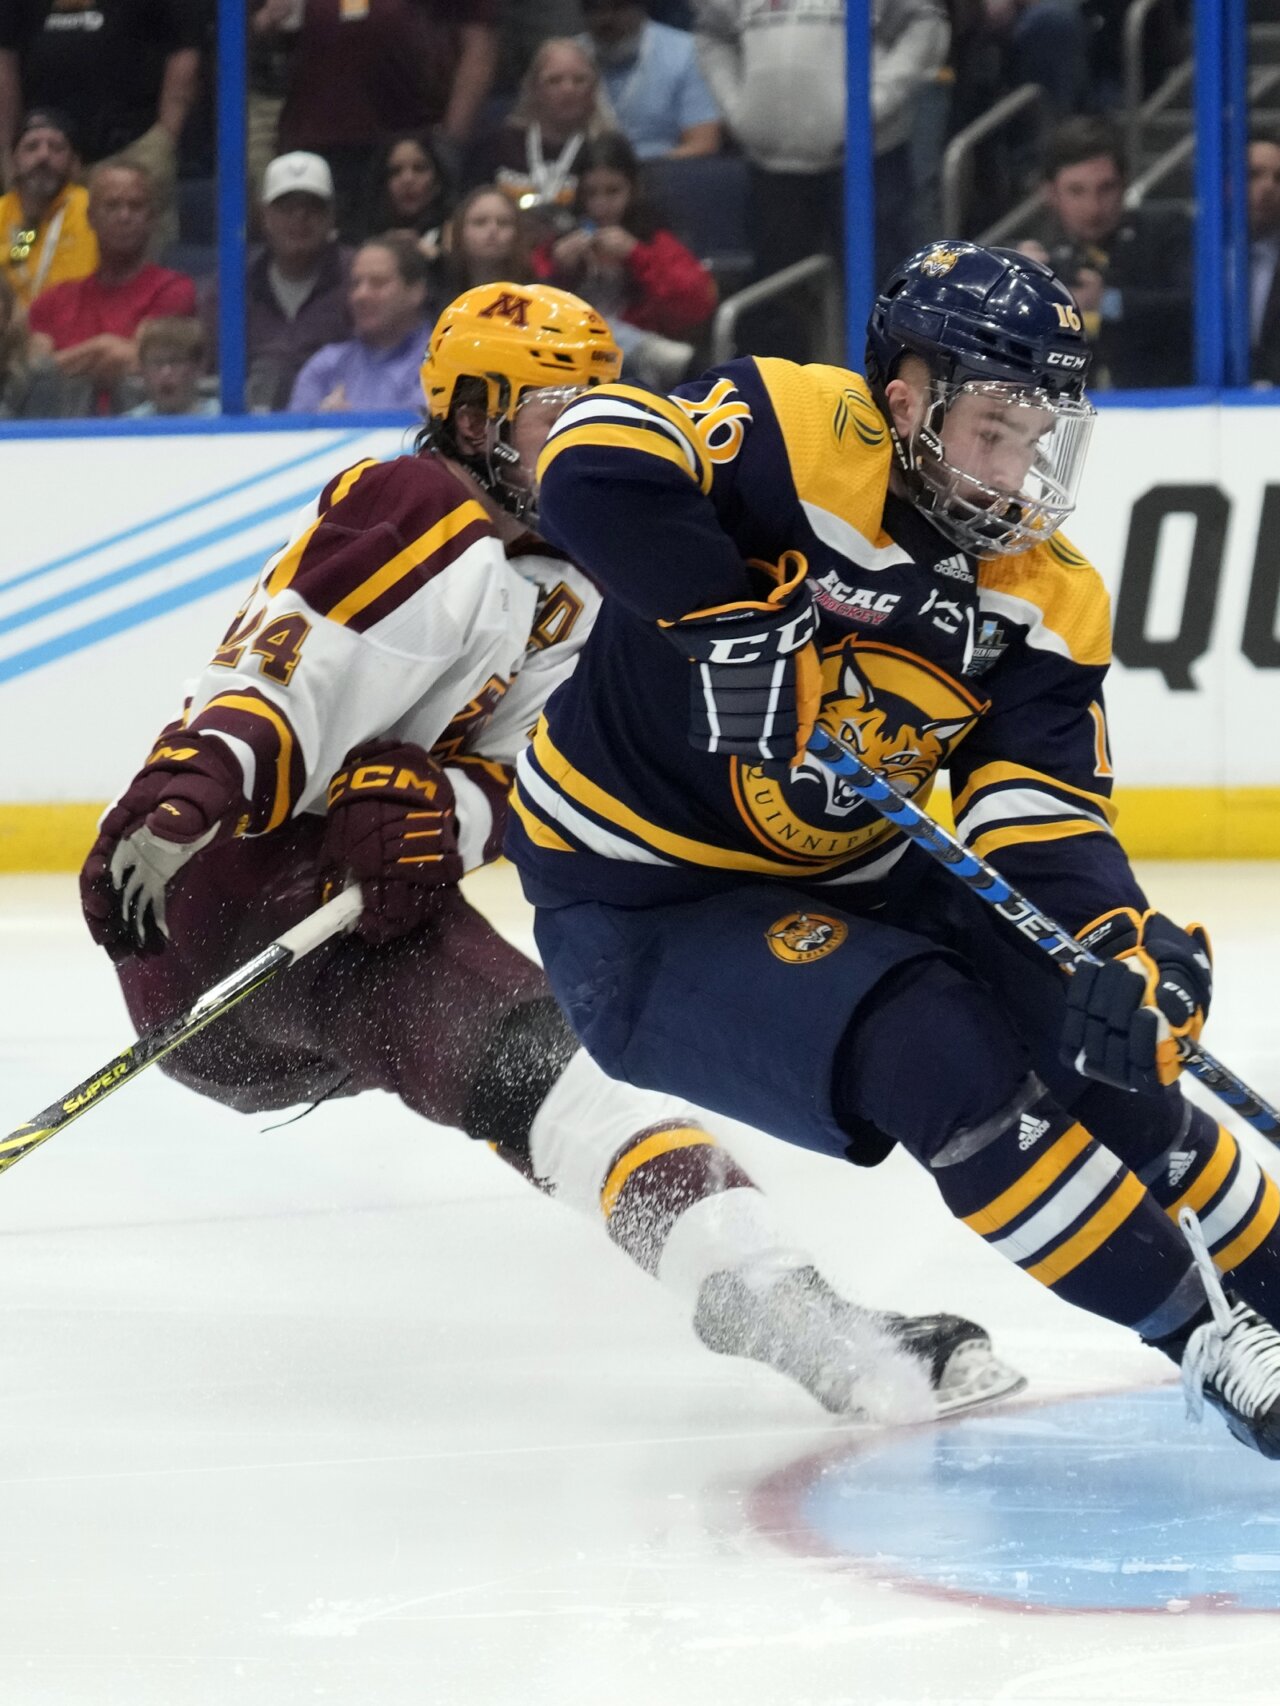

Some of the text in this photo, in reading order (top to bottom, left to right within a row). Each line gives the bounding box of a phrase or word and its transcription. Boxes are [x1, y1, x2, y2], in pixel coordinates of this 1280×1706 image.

[478, 291, 532, 328] M
[1053, 302, 1081, 331] 16
[1046, 352, 1087, 369] CCM
[816, 569, 902, 613] ECAC
[933, 563, 976, 584] adidas
[708, 594, 820, 664] CC
[327, 764, 438, 806] CCM
[745, 757, 893, 852] QUINNIPI
[62, 1062, 127, 1114] SUPER
[1018, 1119, 1051, 1151] adidas
